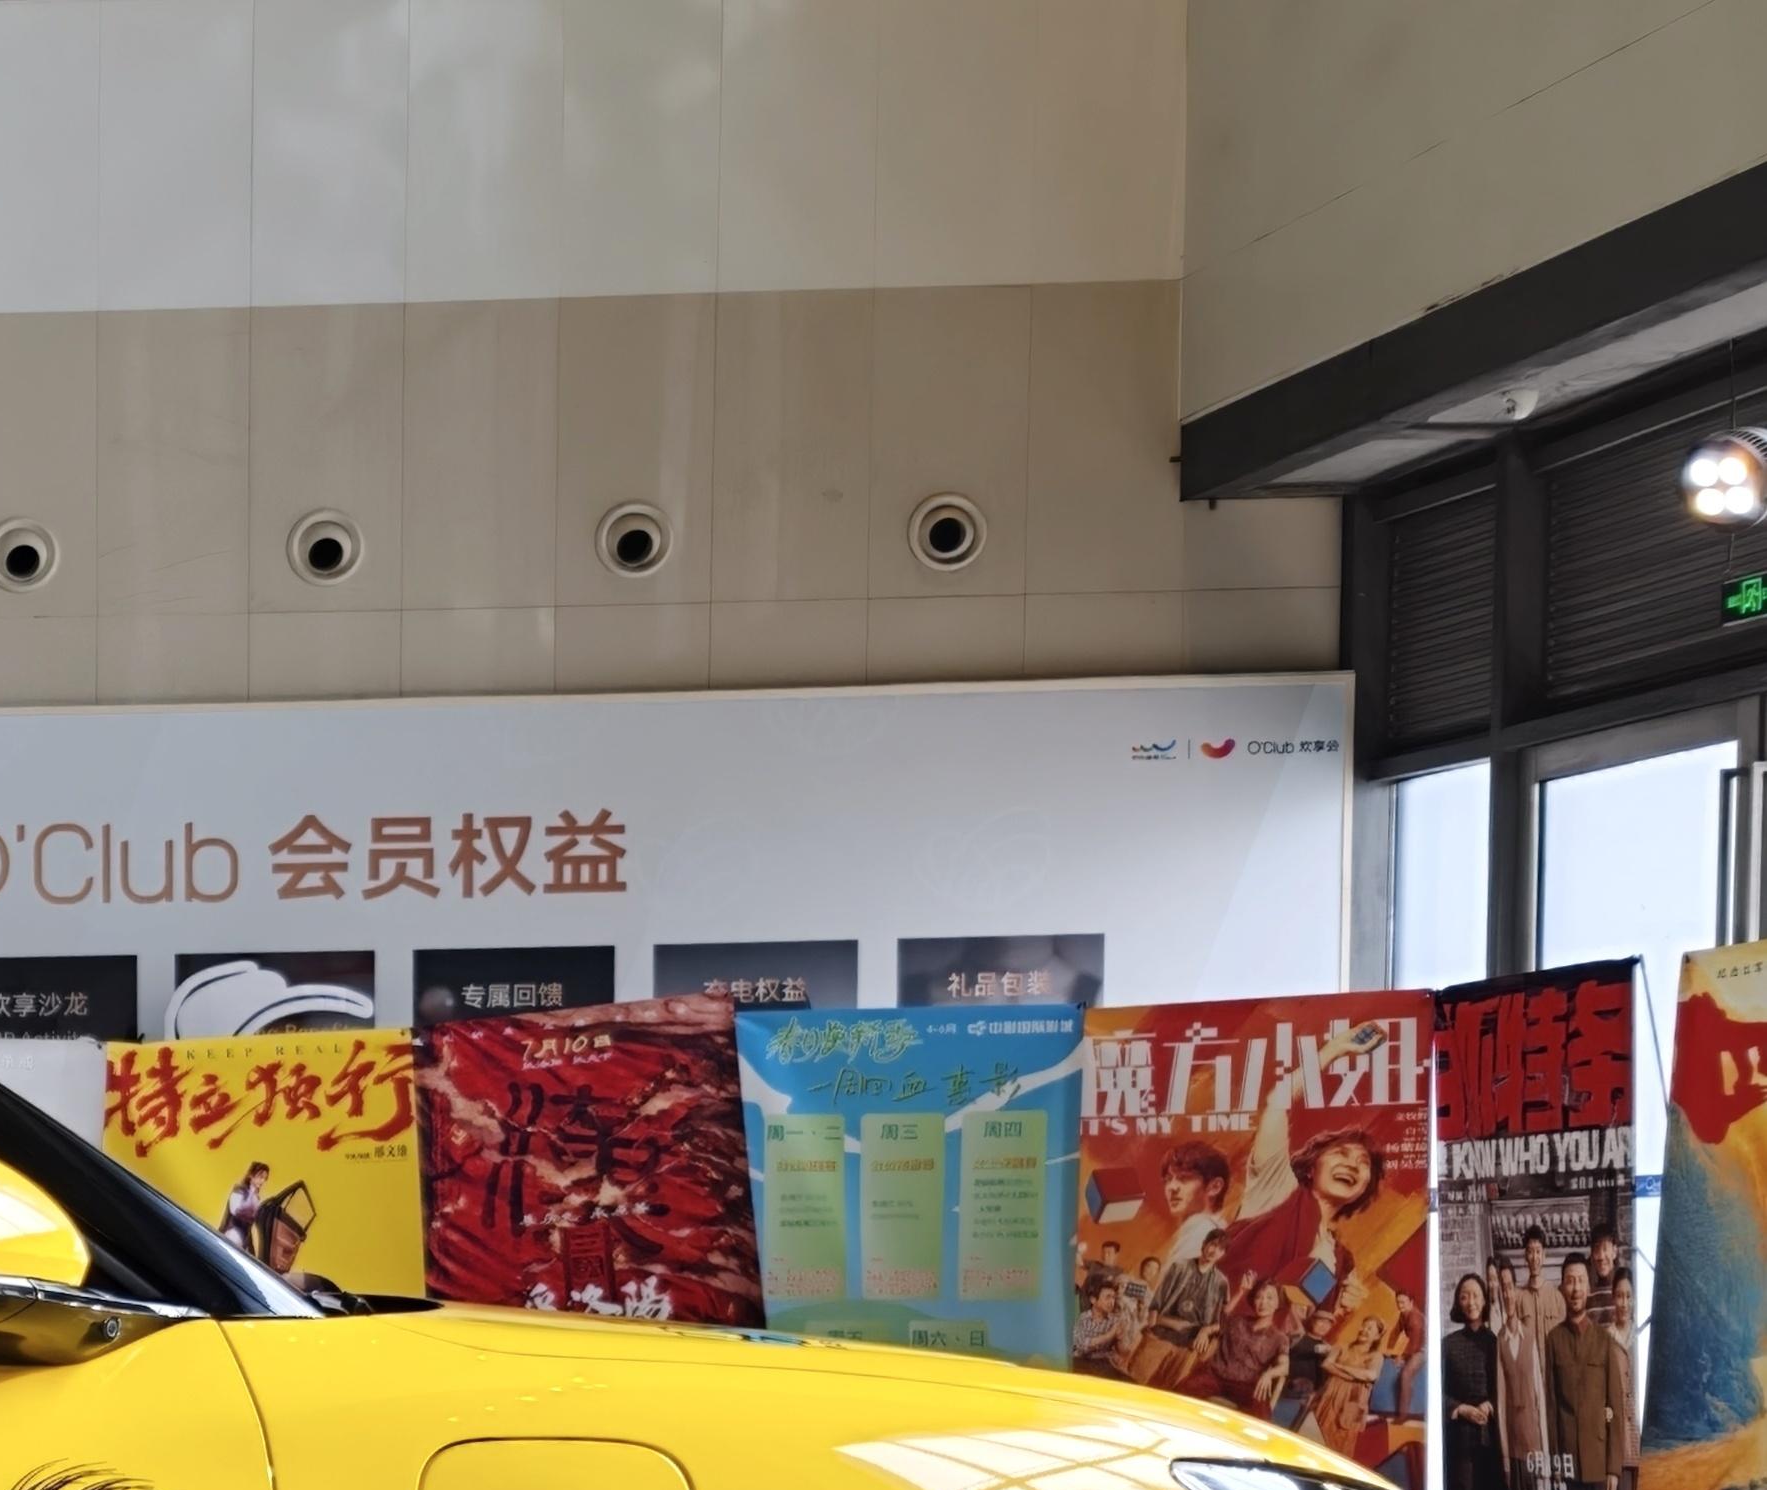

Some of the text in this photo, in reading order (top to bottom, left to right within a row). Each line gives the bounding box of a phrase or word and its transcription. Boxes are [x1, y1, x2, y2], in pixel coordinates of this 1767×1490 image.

[1247, 739, 1295, 756] O'Club
[267, 808, 629, 903] 会员权益
[461, 982, 563, 1009] 专属回馈
[947, 971, 1050, 998] 礼品包装
[186, 1046, 344, 1061] KEEP REAL
[1070, 1017, 1430, 1119] 魔方小姐
[880, 1124, 918, 1140] 周三
[983, 1121, 1023, 1138] 周四
[1080, 1114, 1257, 1136] IT'S MY TIME
[1497, 1133, 1550, 1177] WHO
[1553, 1128, 1600, 1173] YOU
[1601, 1125, 1634, 1169] AR
